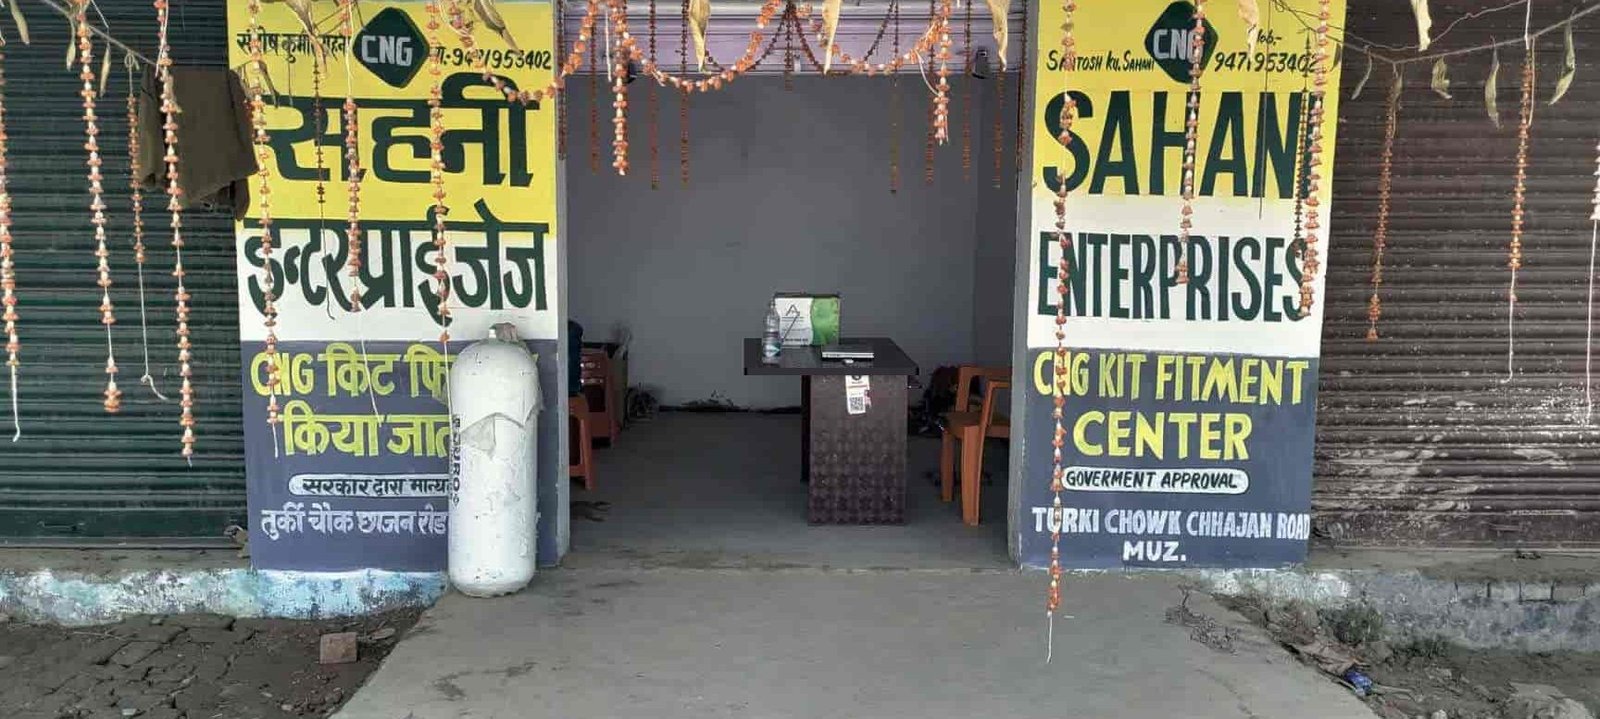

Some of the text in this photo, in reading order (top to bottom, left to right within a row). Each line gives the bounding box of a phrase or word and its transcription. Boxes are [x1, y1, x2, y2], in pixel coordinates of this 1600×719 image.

[361, 34, 412, 66] CNG
[1153, 28, 1204, 64] CNG
[252, 72, 540, 187] सहनी
[1037, 231, 1308, 322] ENTERPRISES
[250, 351, 315, 396] CNG
[317, 343, 401, 398] किट
[1033, 351, 1309, 406] CNG KIT FITMENT
[276, 400, 385, 457] किया
[1073, 411, 1253, 461] CENTER
[302, 478, 373, 496] सरकार
[1066, 470, 1238, 490] GOVERMENT APPROVAL
[1032, 507, 1311, 540] TURKI CHOWK CHHAJAN ROAD
[1123, 541, 1187, 562] MUZ.
